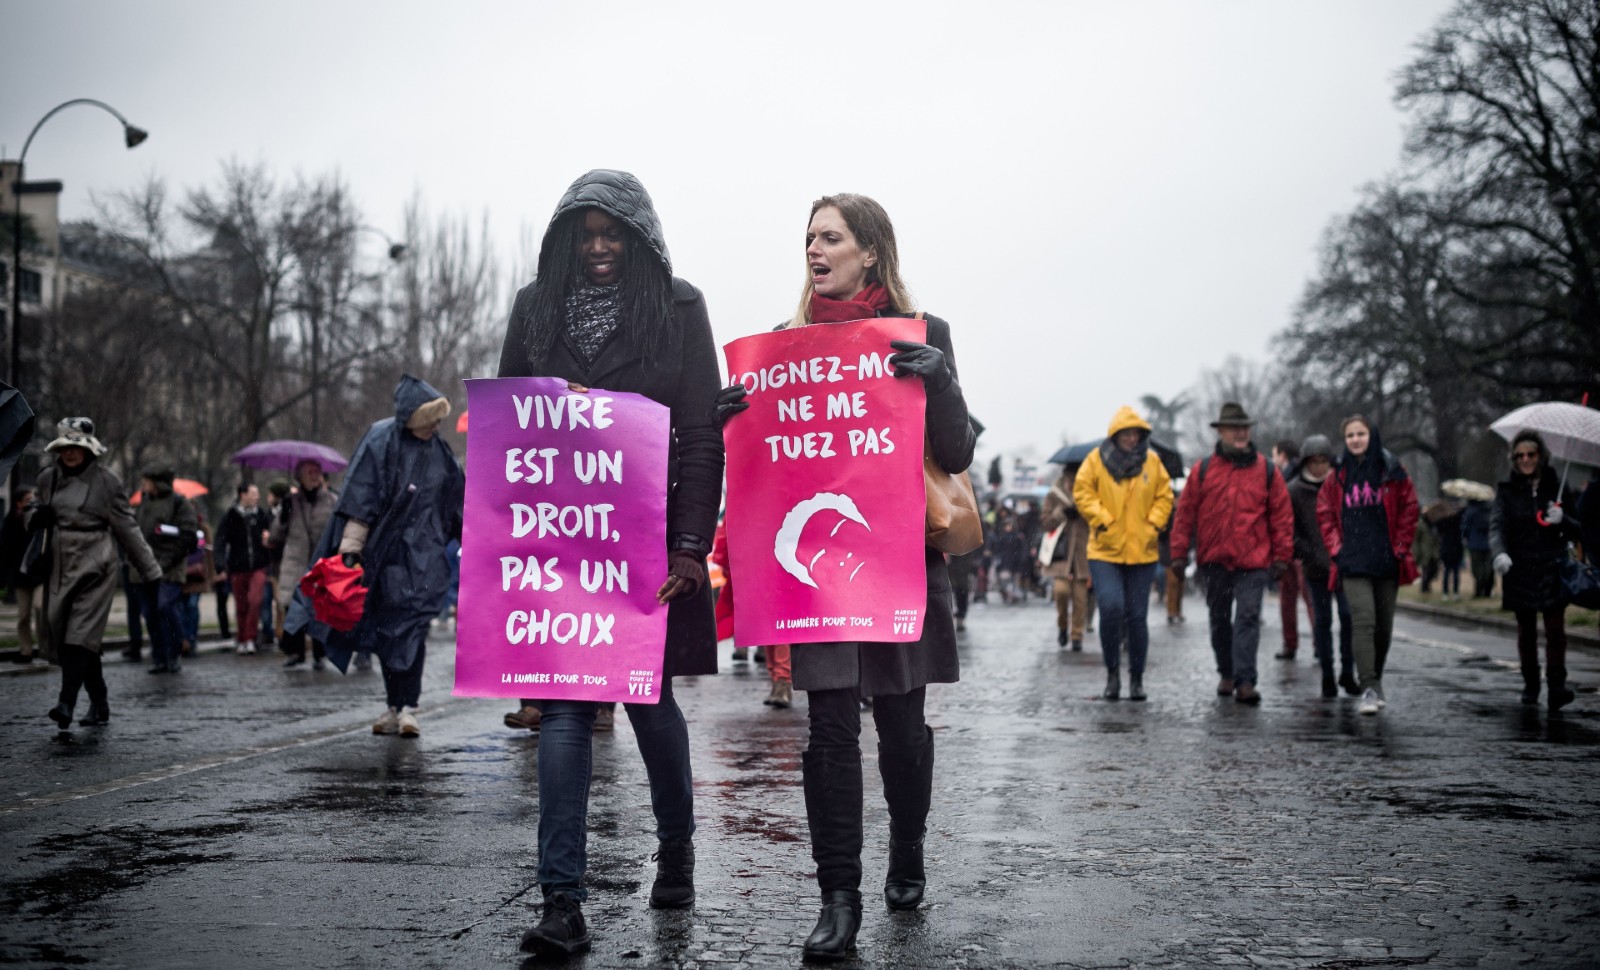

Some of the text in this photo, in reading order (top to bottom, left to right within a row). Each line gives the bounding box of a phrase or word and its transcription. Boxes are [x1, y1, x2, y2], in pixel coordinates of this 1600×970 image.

[731, 352, 898, 395] OIGNEZ-MO
[511, 394, 614, 431] VIVRE
[777, 391, 868, 423] NE ME
[765, 427, 895, 463] TUEZ PAS
[505, 448, 623, 485] EST UN
[509, 502, 620, 543] DROIT,
[499, 556, 629, 594] PAS UN
[505, 608, 615, 647] CHOIX
[776, 616, 874, 630] LA LUMIÈRE POUR TOUS
[893, 622, 915, 635] VIE
[501, 672, 608, 686] LA LUMIÈRE POUR TOUS
[628, 682, 652, 697] VIE
